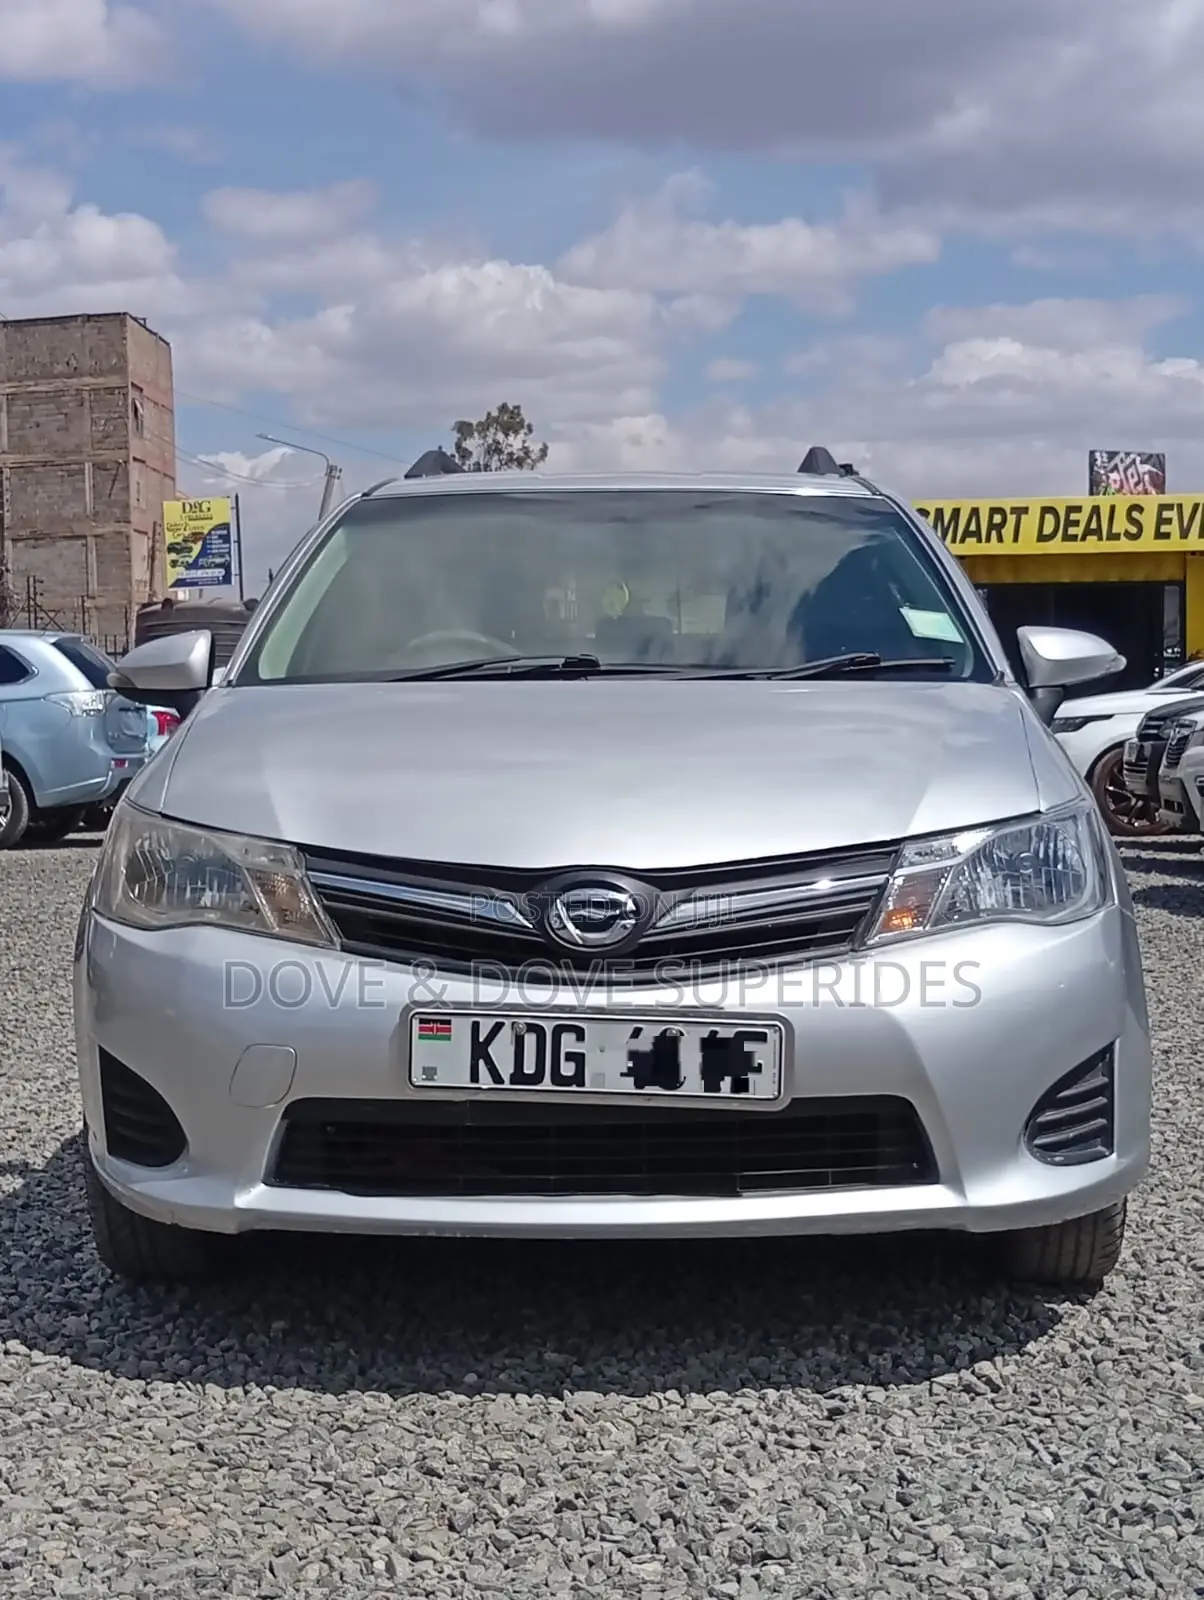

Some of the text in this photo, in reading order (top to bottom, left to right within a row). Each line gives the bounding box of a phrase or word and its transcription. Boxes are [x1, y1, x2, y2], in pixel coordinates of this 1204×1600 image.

[1036, 503, 1144, 543] DEALS
[1153, 502, 1204, 540] EV
[469, 1020, 586, 1087] KDG
